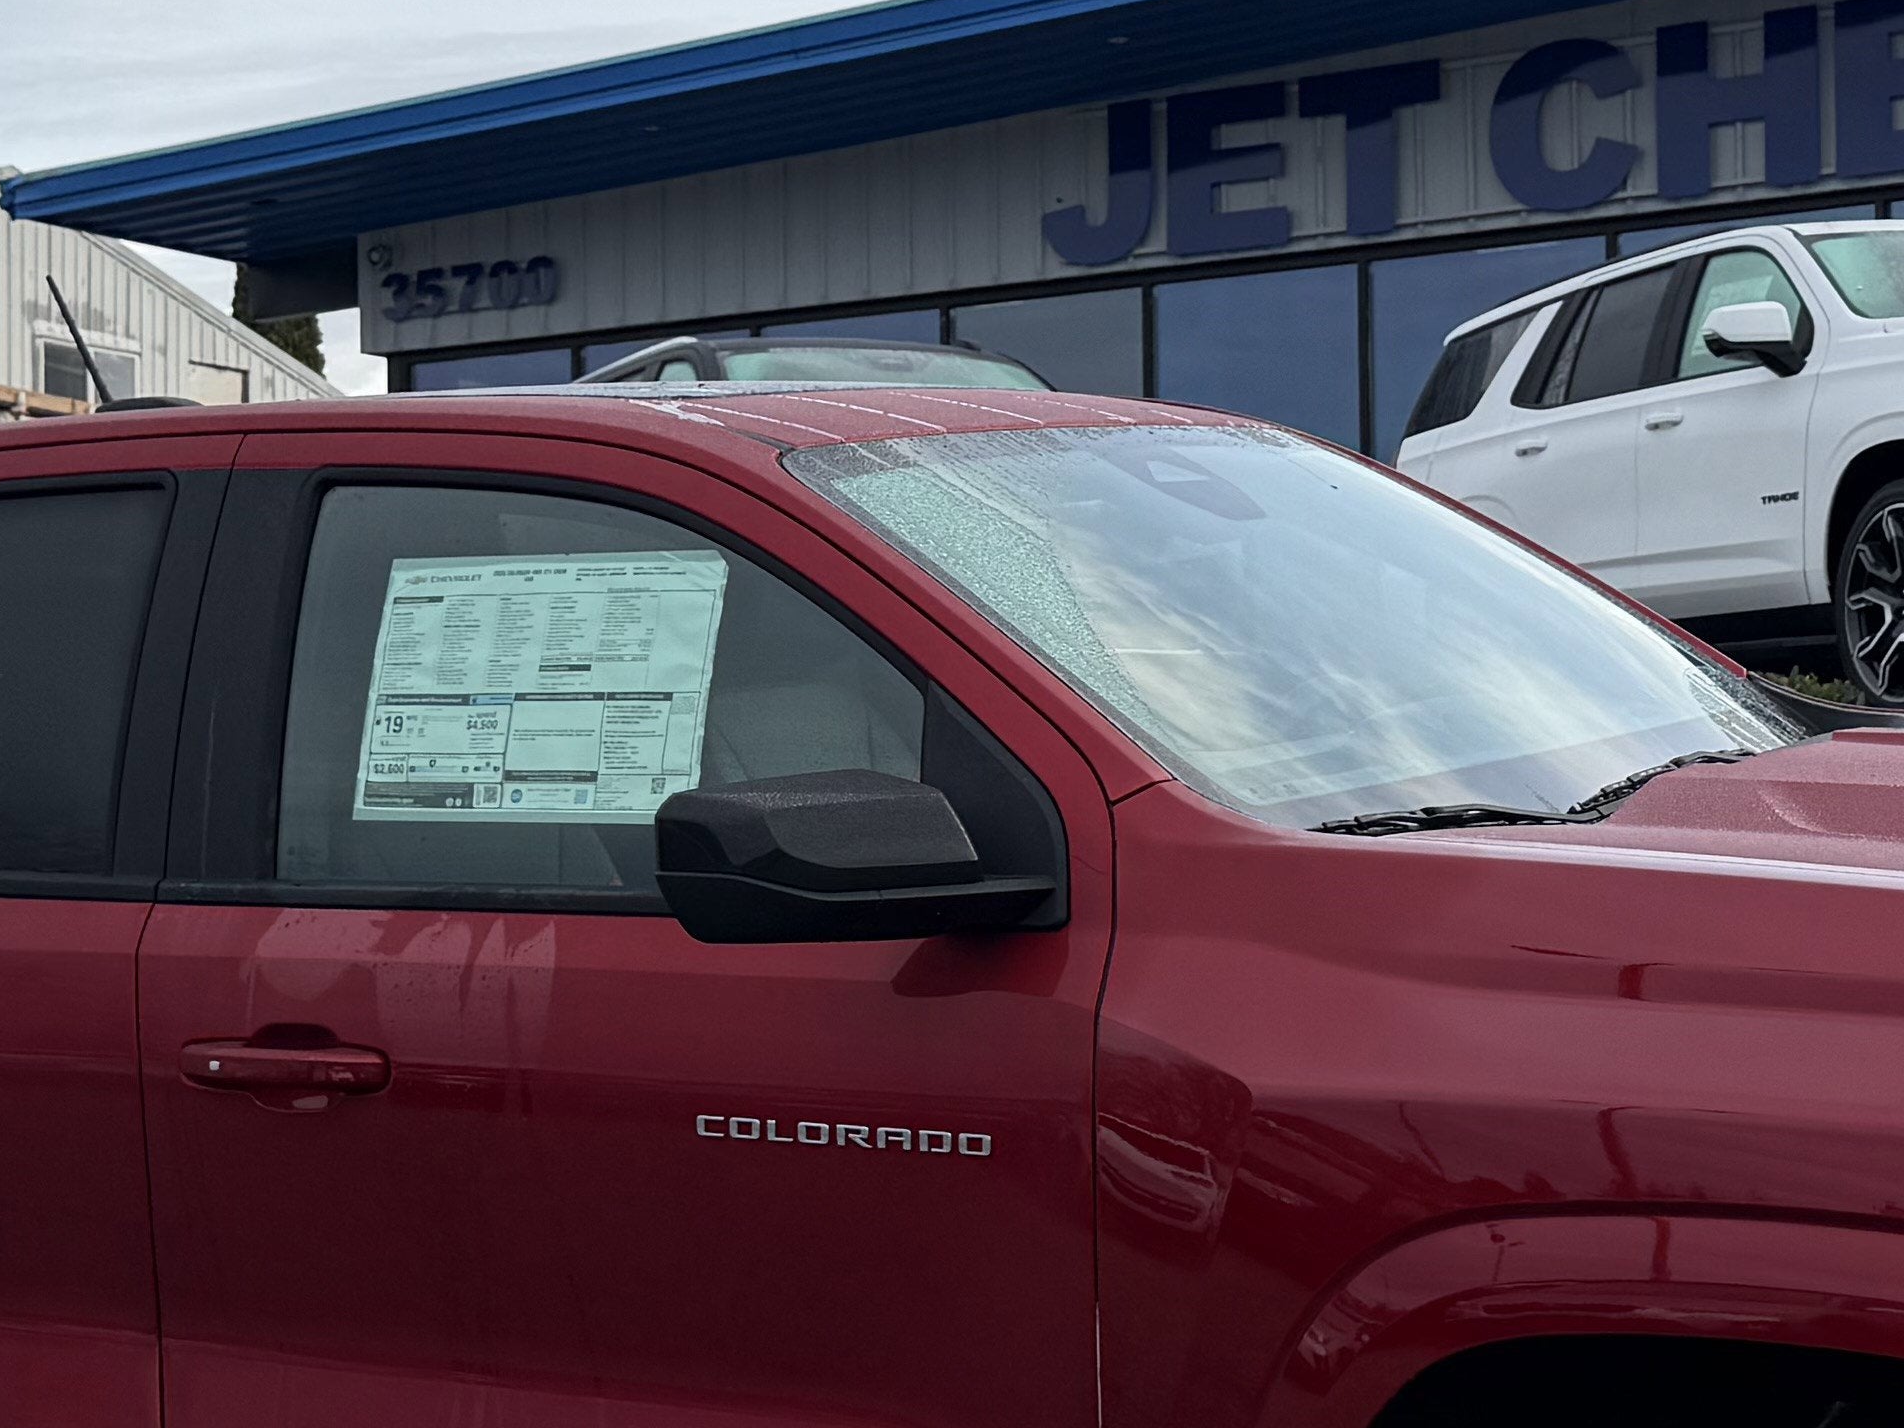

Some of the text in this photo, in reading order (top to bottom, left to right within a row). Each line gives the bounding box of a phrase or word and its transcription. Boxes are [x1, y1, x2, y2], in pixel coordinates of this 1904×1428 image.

[1042, 59, 1440, 267] JET
[382, 256, 559, 321] 35700
[1761, 491, 1800, 505] TAHOE
[384, 715, 404, 734] 19
[695, 1114, 992, 1157] COLORADO
